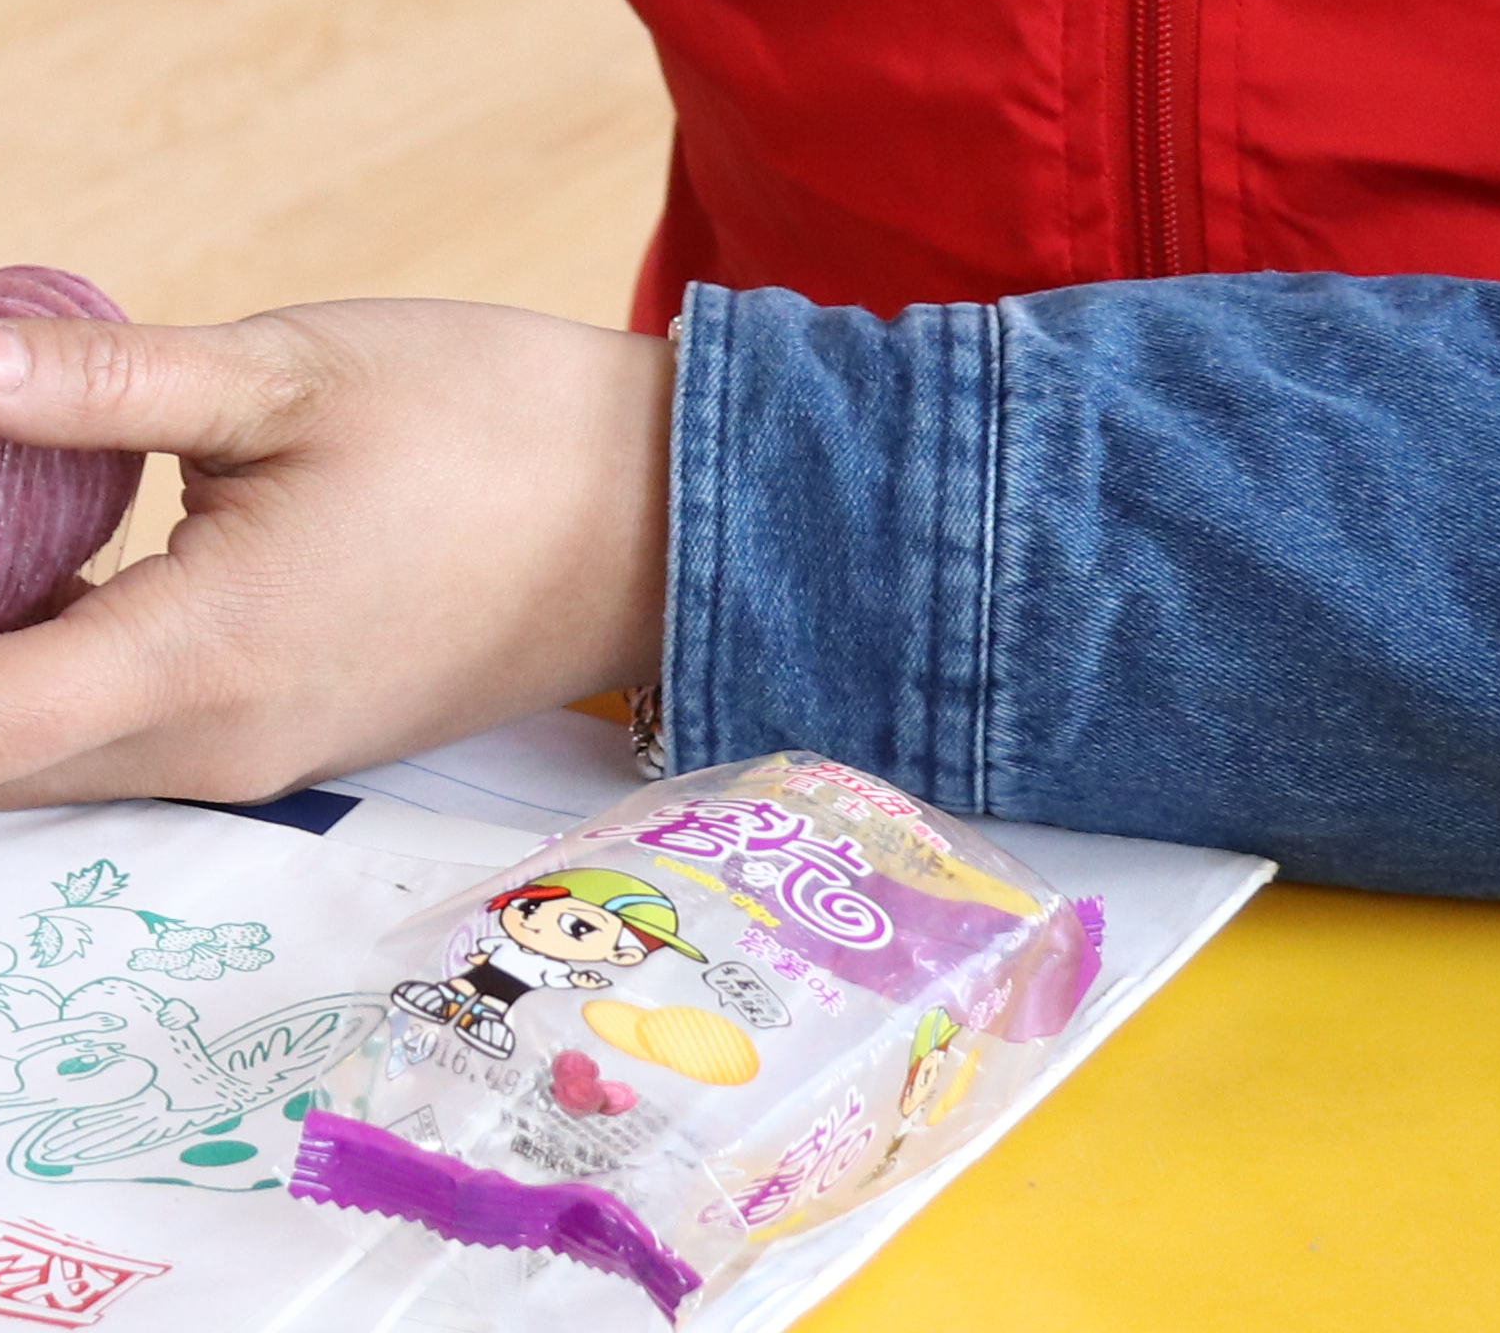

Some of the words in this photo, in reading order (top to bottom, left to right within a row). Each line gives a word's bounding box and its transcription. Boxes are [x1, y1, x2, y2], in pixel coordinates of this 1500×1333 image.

[583, 799, 896, 950] 薯片
[735, 928, 846, 1016] 紫薯味
